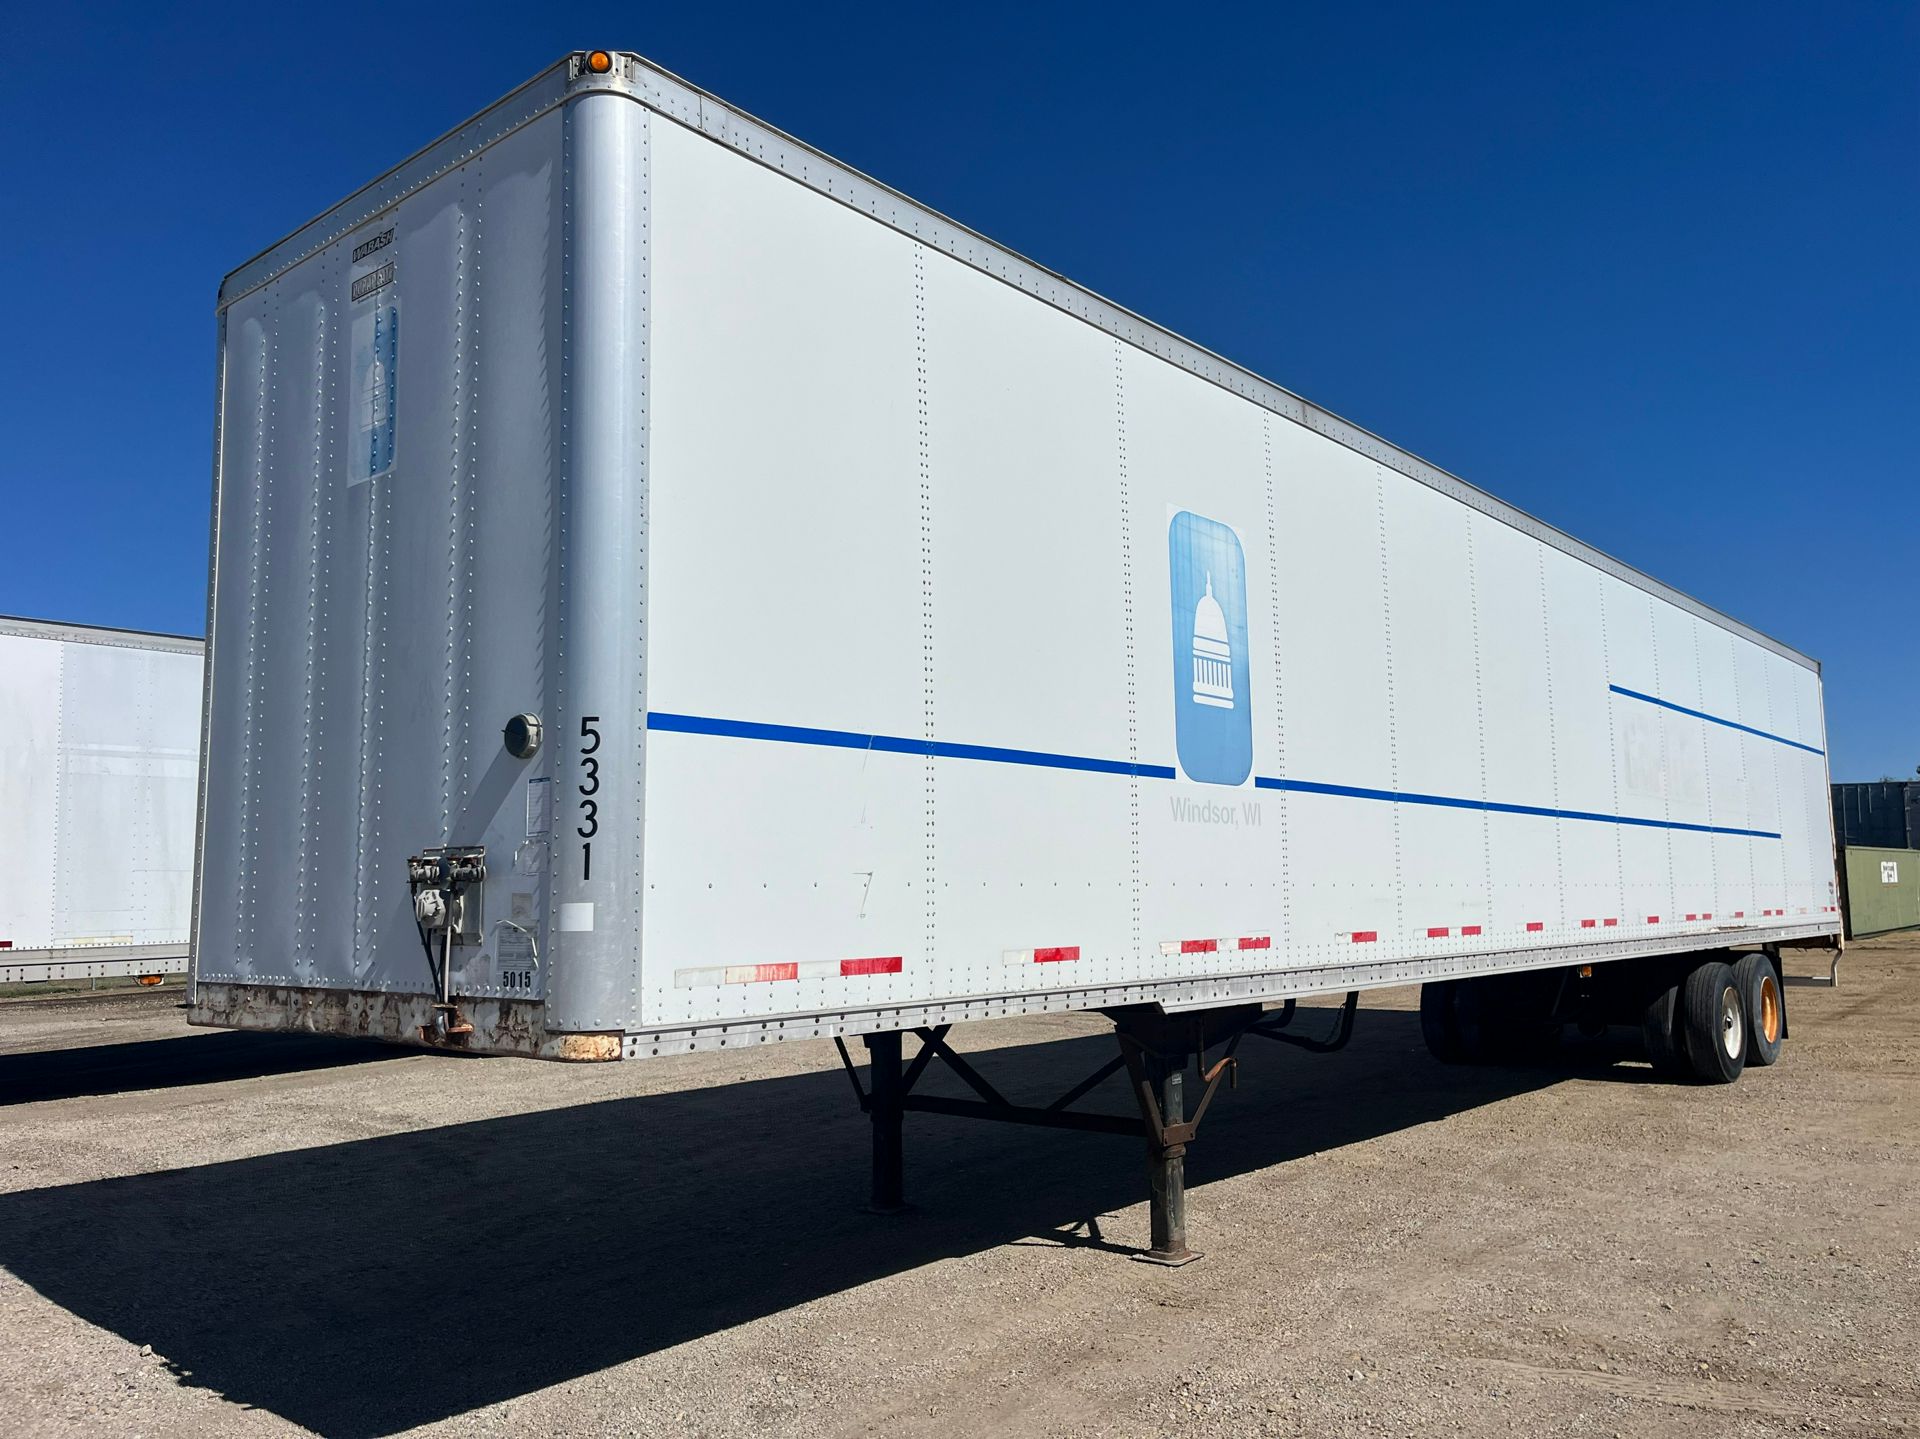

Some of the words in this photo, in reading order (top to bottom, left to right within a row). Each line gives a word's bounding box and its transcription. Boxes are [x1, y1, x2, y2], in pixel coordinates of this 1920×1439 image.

[353, 228, 393, 263] WABASH
[577, 716, 600, 880] 5331
[1170, 796, 1239, 829] Windsor,
[1242, 802, 1262, 826] WI
[503, 971, 531, 988] 5015
